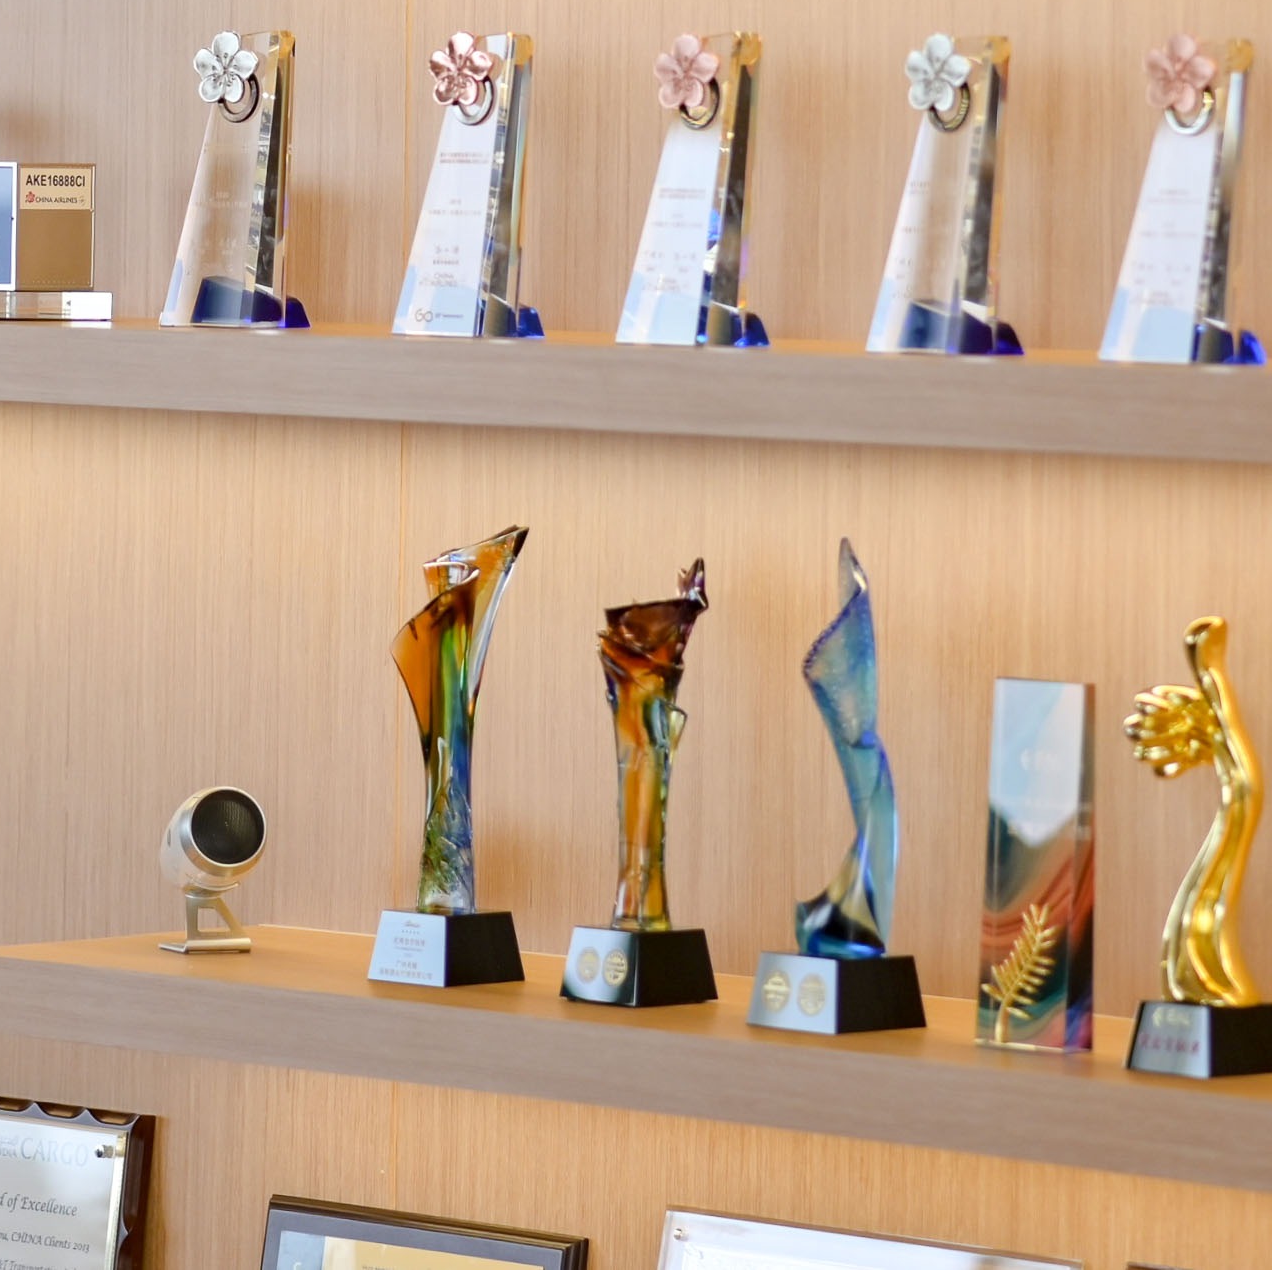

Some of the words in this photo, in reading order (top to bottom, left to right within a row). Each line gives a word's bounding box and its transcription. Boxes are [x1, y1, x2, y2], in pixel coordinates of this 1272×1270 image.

[25, 174, 86, 187] AKE16888CI
[35, 195, 53, 204] CHINA
[54, 195, 78, 204] AIRLINES
[20, 1134, 90, 1168] CARGO
[6, 1194, 21, 1213] of
[21, 1196, 78, 1217] Excellence
[11, 1231, 43, 1246] CHINA
[44, 1234, 72, 1250] Clients
